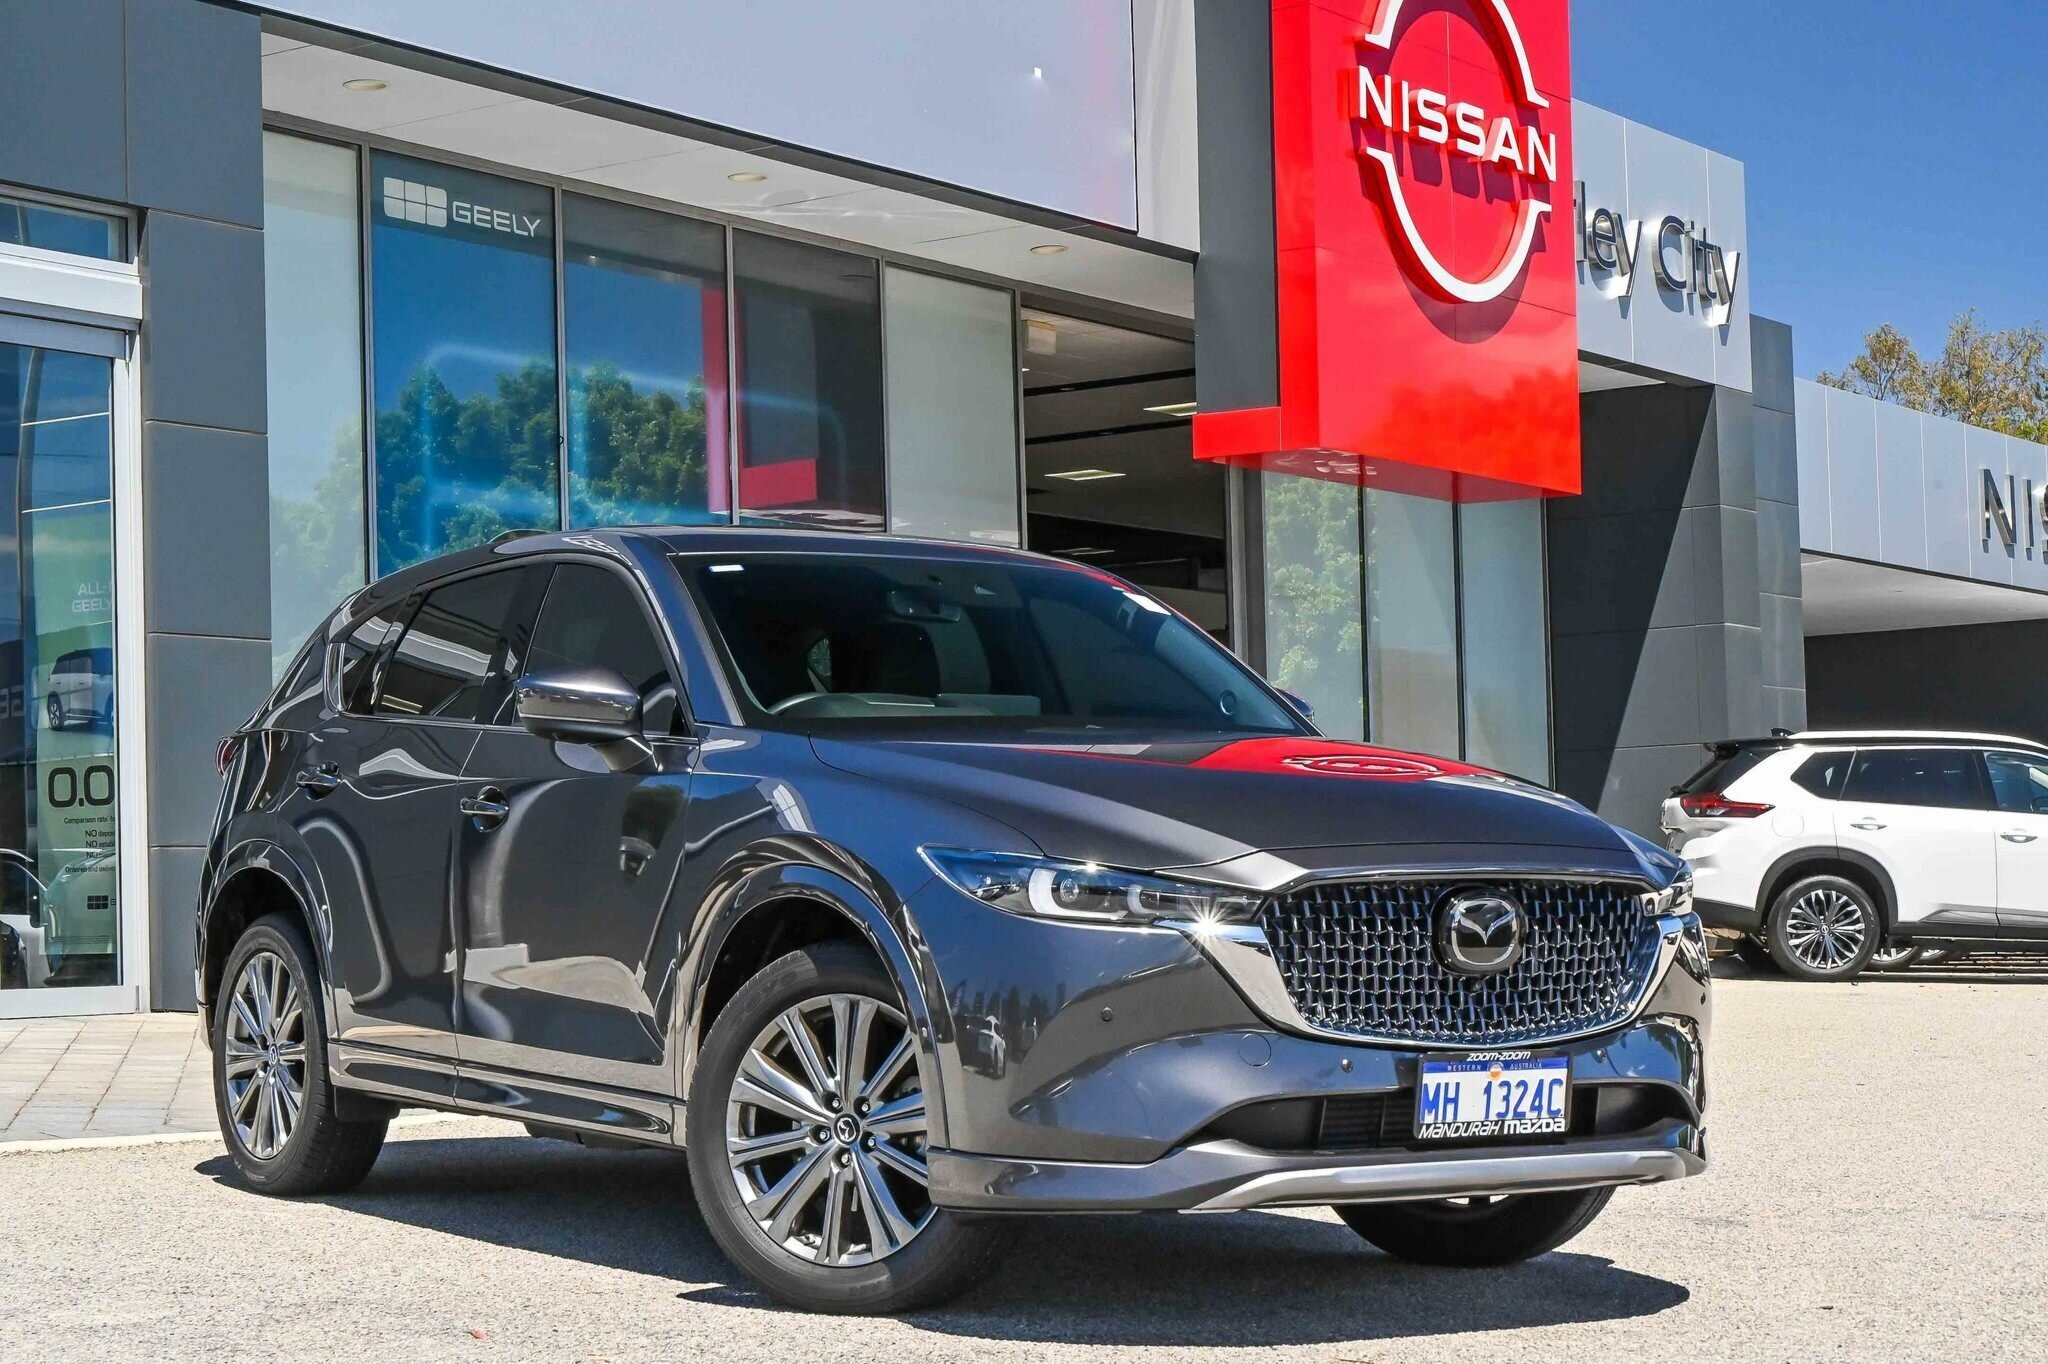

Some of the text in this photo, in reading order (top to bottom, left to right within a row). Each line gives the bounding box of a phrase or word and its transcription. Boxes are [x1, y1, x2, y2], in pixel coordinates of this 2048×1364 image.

[1358, 65, 1557, 183] NISSAN
[452, 200, 541, 238] GEELY
[1573, 180, 1741, 326] ley City
[48, 765, 114, 808] 0.0
[64, 816, 97, 825] Comparison
[85, 830, 97, 838] NO
[86, 840, 97, 848] NO
[1447, 1061, 1543, 1072] WESTERN AUSTRALIA
[1466, 1051, 1531, 1061] zoom-zoom
[1421, 1078, 1564, 1123] MH 1324C
